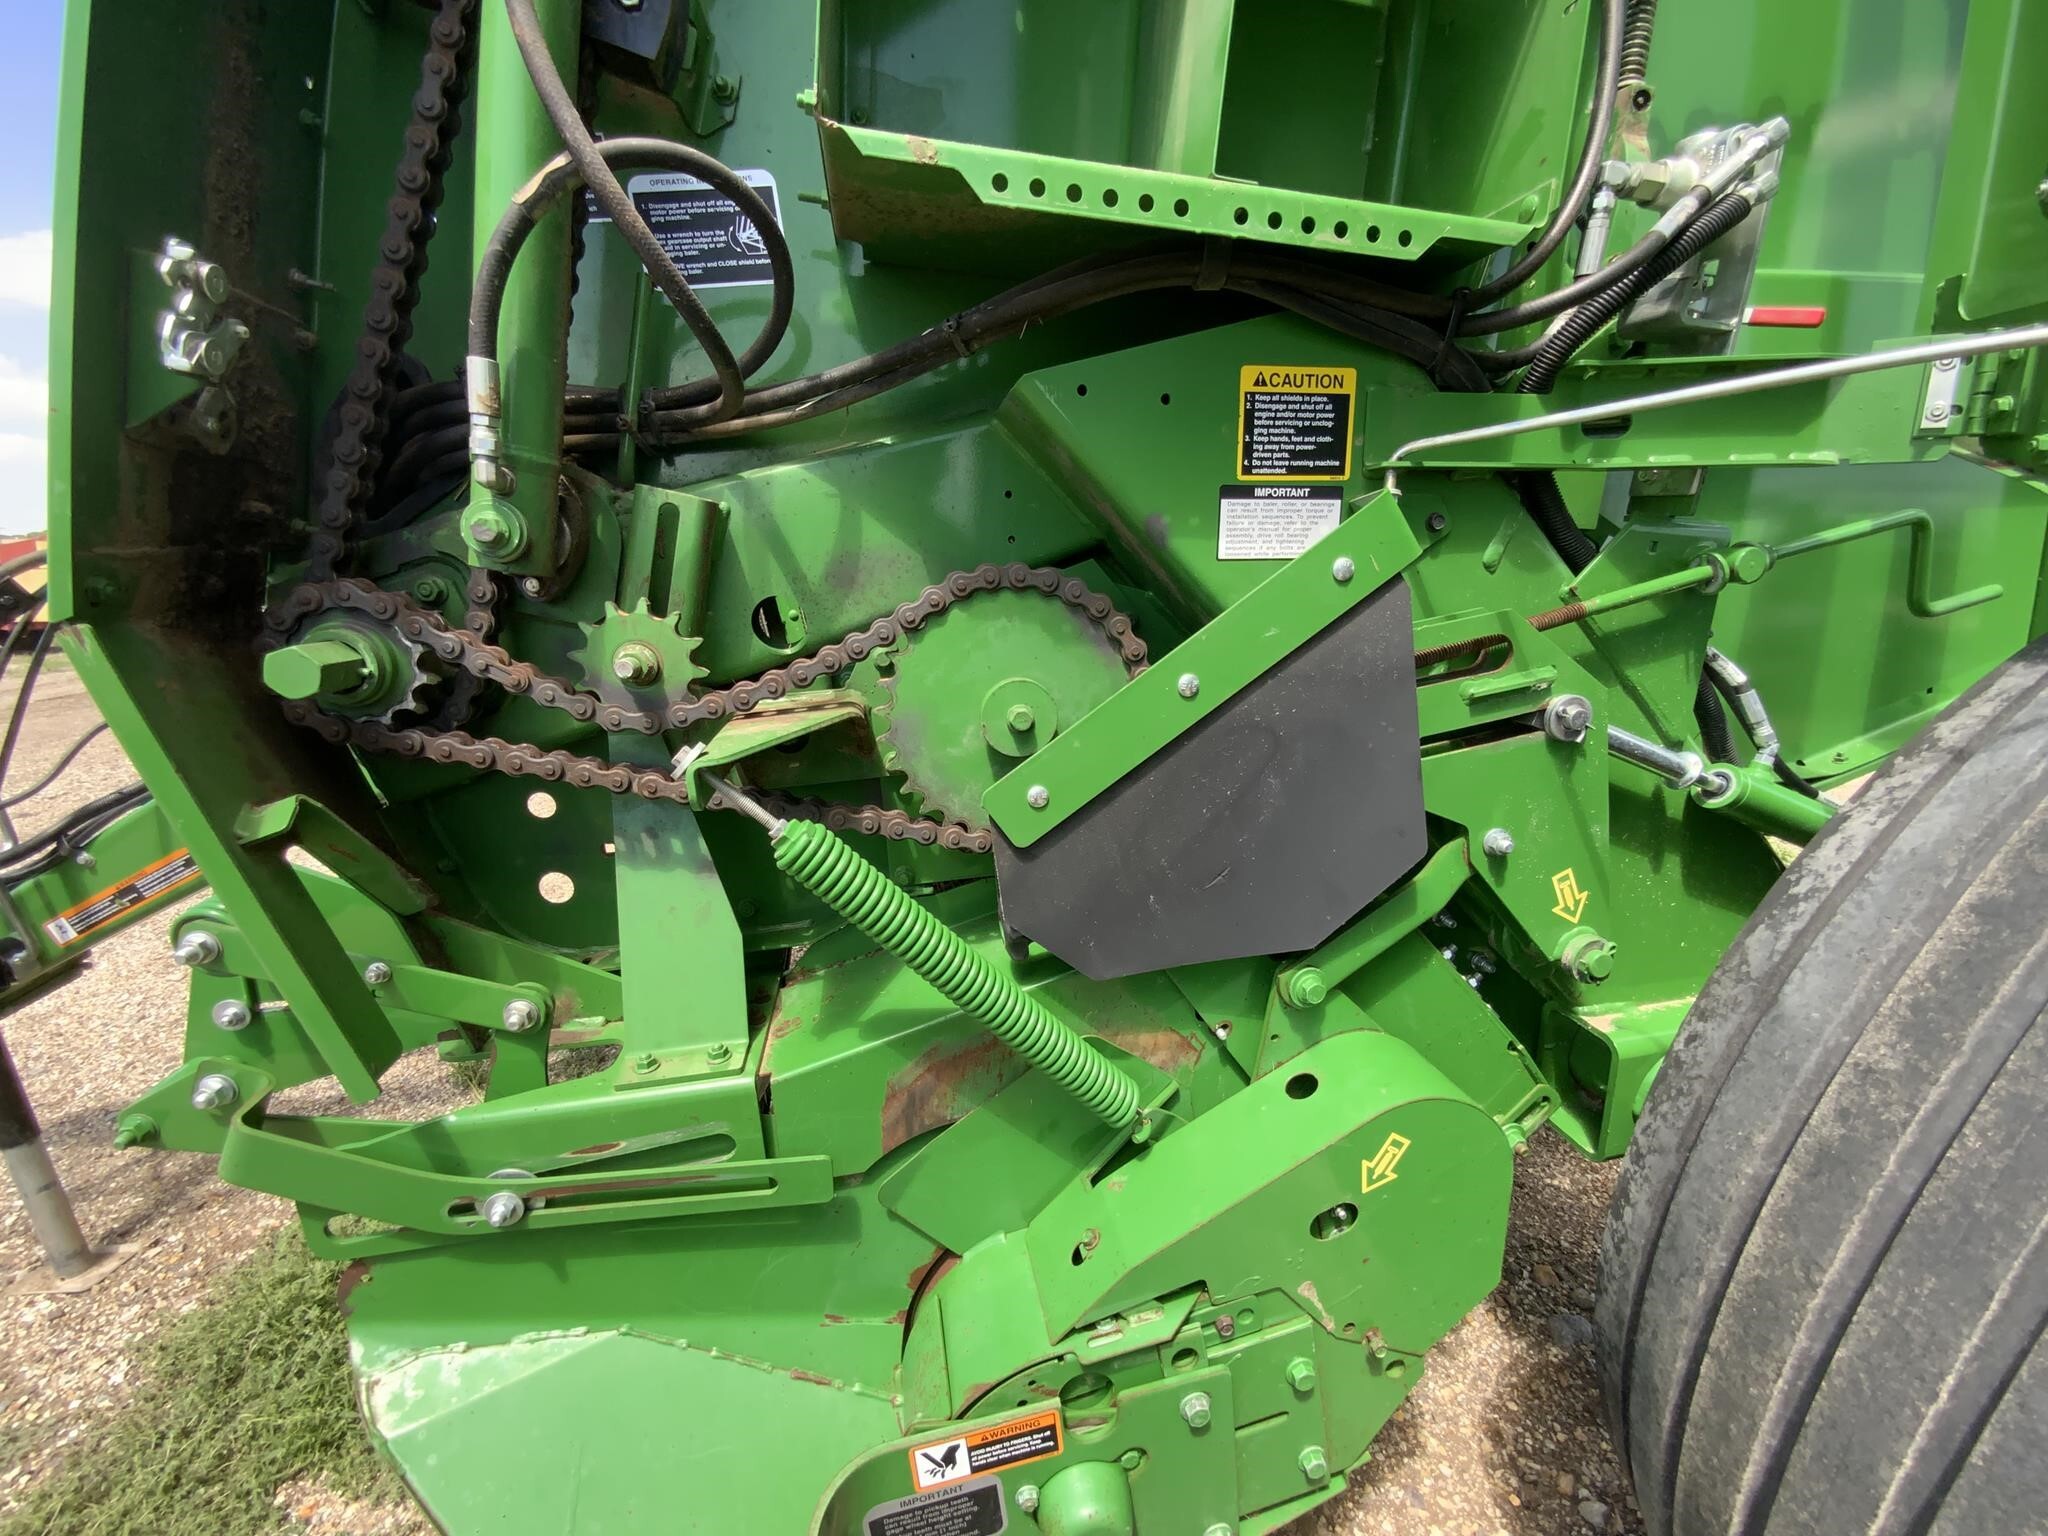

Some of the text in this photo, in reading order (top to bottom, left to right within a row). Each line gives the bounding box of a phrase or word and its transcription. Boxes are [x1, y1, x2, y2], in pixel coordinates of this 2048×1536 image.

[649, 178, 694, 187] OPERATING
[649, 202, 680, 210] Disengage
[669, 208, 686, 216] power
[707, 206, 734, 214] servicing
[687, 262, 705, 270] wrench
[1269, 372, 1344, 389] CAUTION
[1255, 394, 1271, 402] Keep
[1255, 402, 1286, 411] Disengage
[1311, 420, 1334, 428] unclog-
[1254, 488, 1310, 497] IMPORTANT
[989, 1420, 1041, 1439] WARNING
[900, 1484, 964, 1508] IMPORTANT
